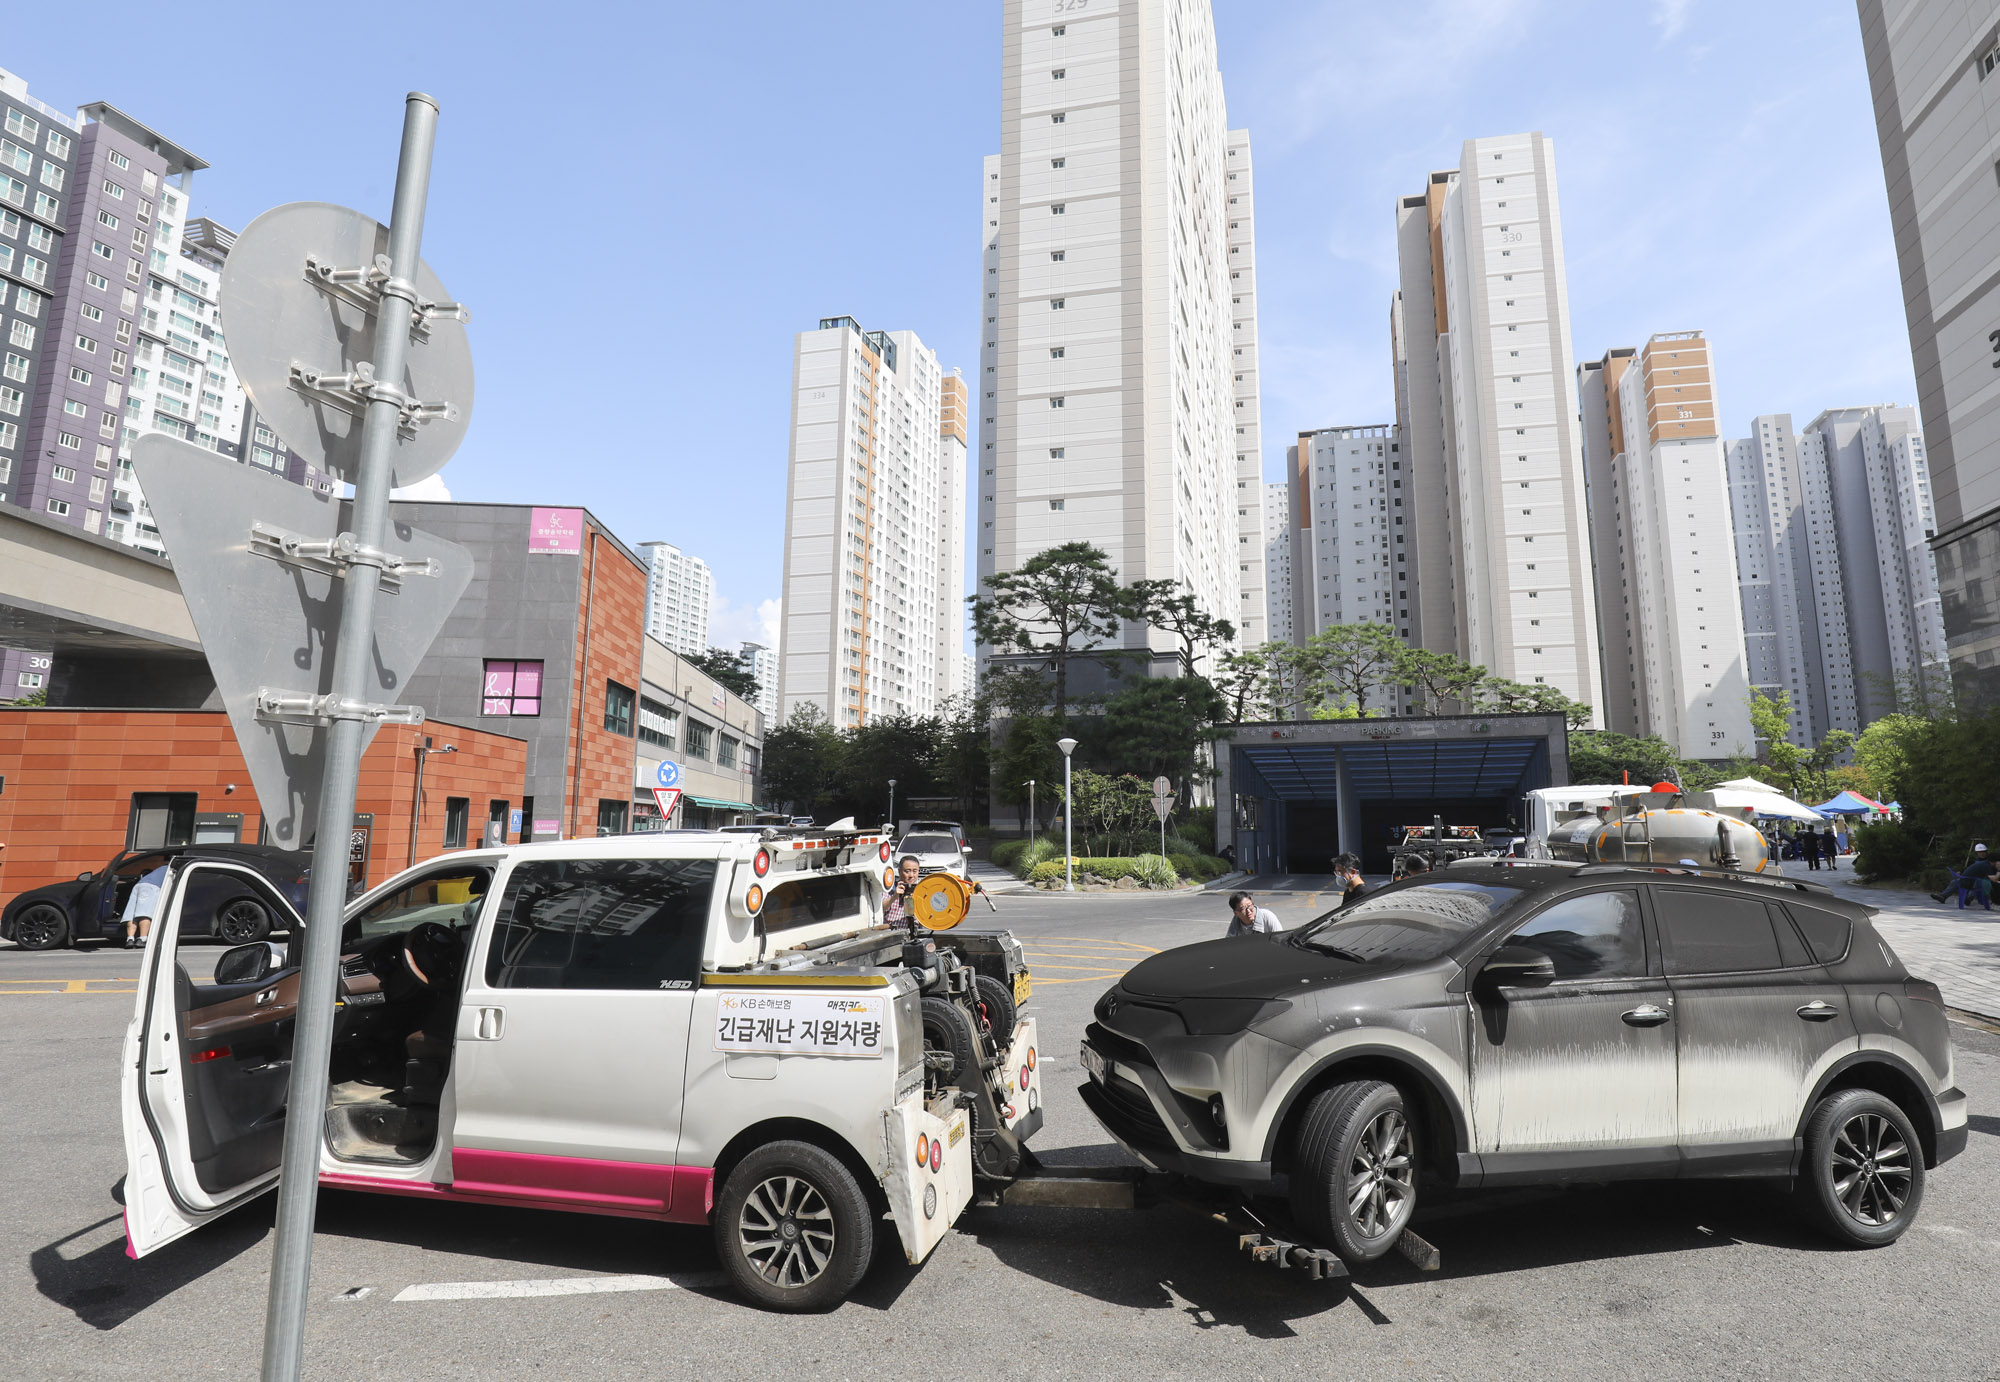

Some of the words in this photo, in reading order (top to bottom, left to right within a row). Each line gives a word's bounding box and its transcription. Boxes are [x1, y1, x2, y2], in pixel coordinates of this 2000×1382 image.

[1502, 232, 1523, 243] 330
[1679, 410, 1693, 418] 331
[1361, 726, 1401, 736] PARKING
[1712, 731, 1725, 739] 331
[660, 979, 693, 989] HSD
[719, 1017, 795, 1043] 긴급재난
[800, 1020, 881, 1047] 지원차량
